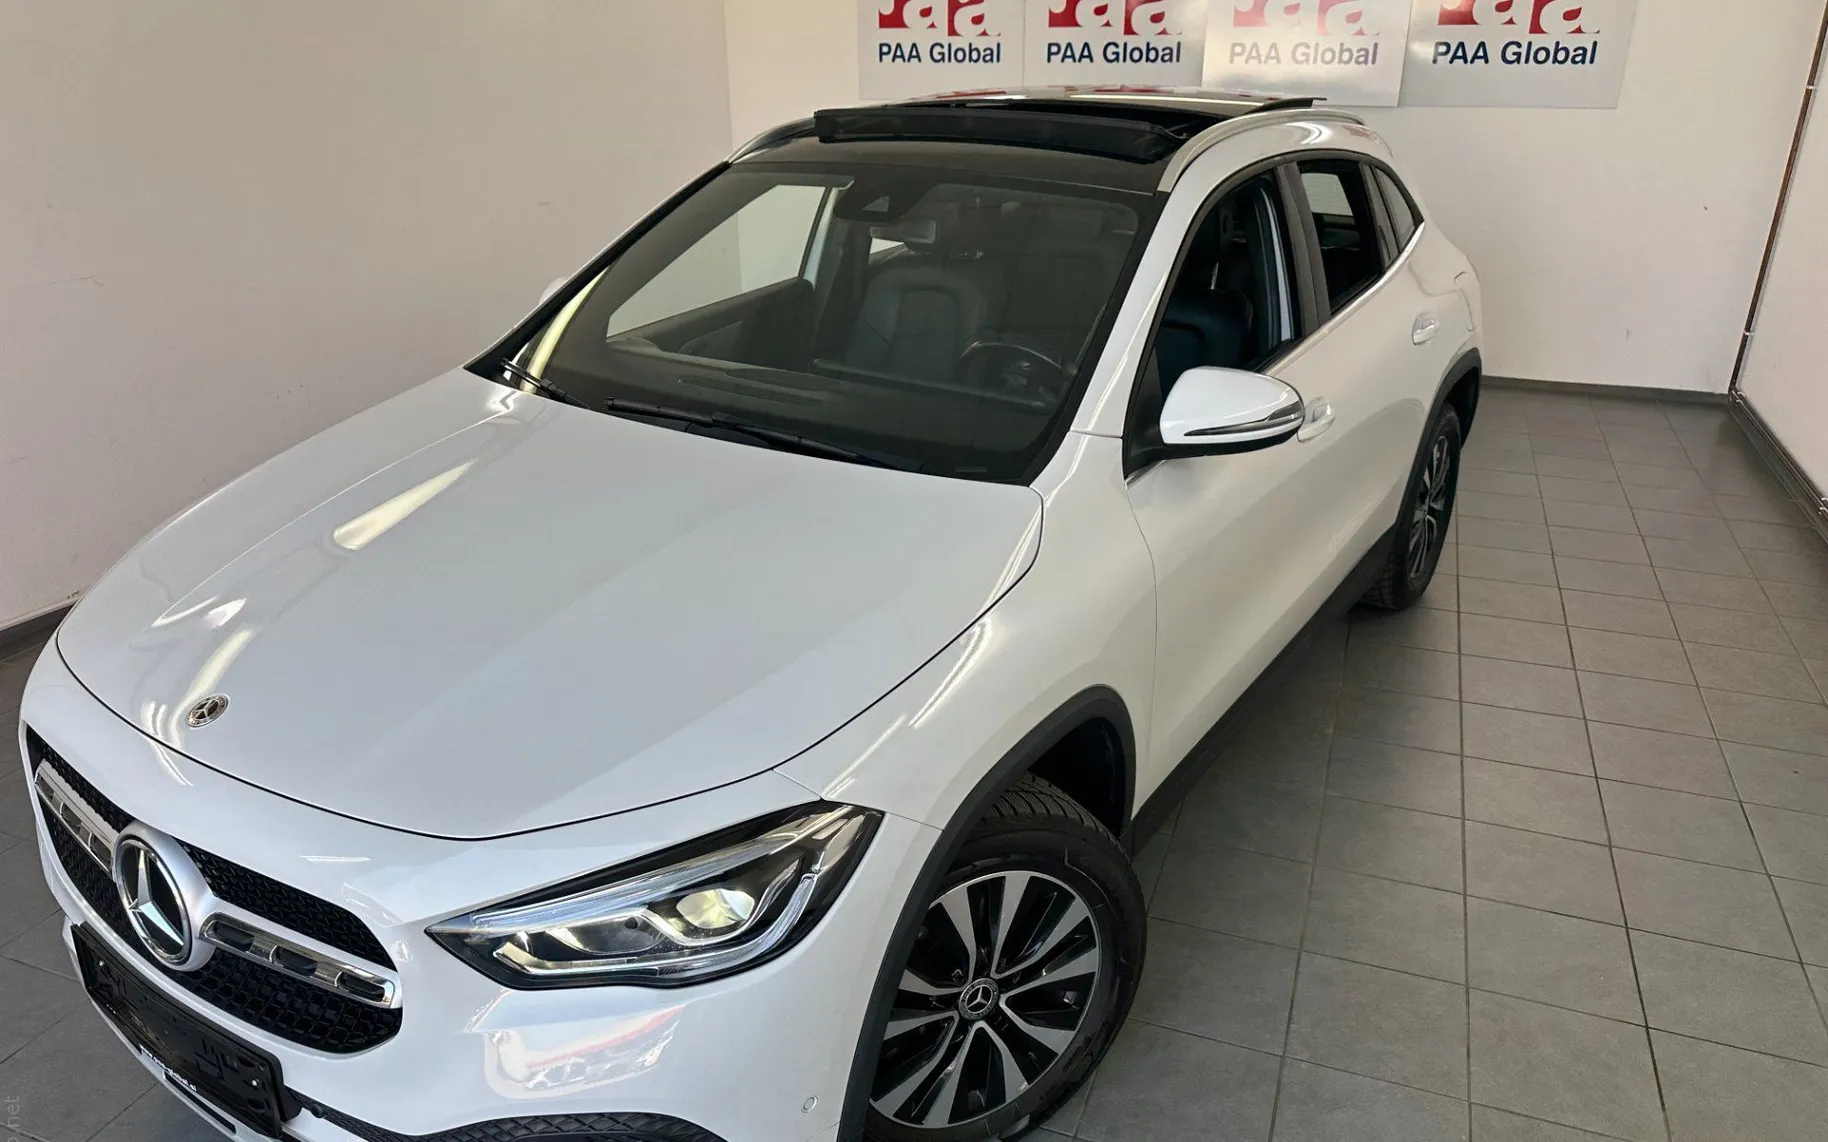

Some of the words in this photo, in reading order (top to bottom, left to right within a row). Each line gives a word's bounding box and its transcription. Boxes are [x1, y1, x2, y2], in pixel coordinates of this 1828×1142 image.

[878, 42, 922, 63] PAA
[929, 42, 1001, 63] Global
[1047, 41, 1094, 63] PAA
[1102, 41, 1182, 63] Global
[1229, 42, 1282, 65] PAA
[1291, 42, 1379, 65] Global
[1432, 41, 1489, 65] PAA
[1501, 40, 1599, 65] Global
